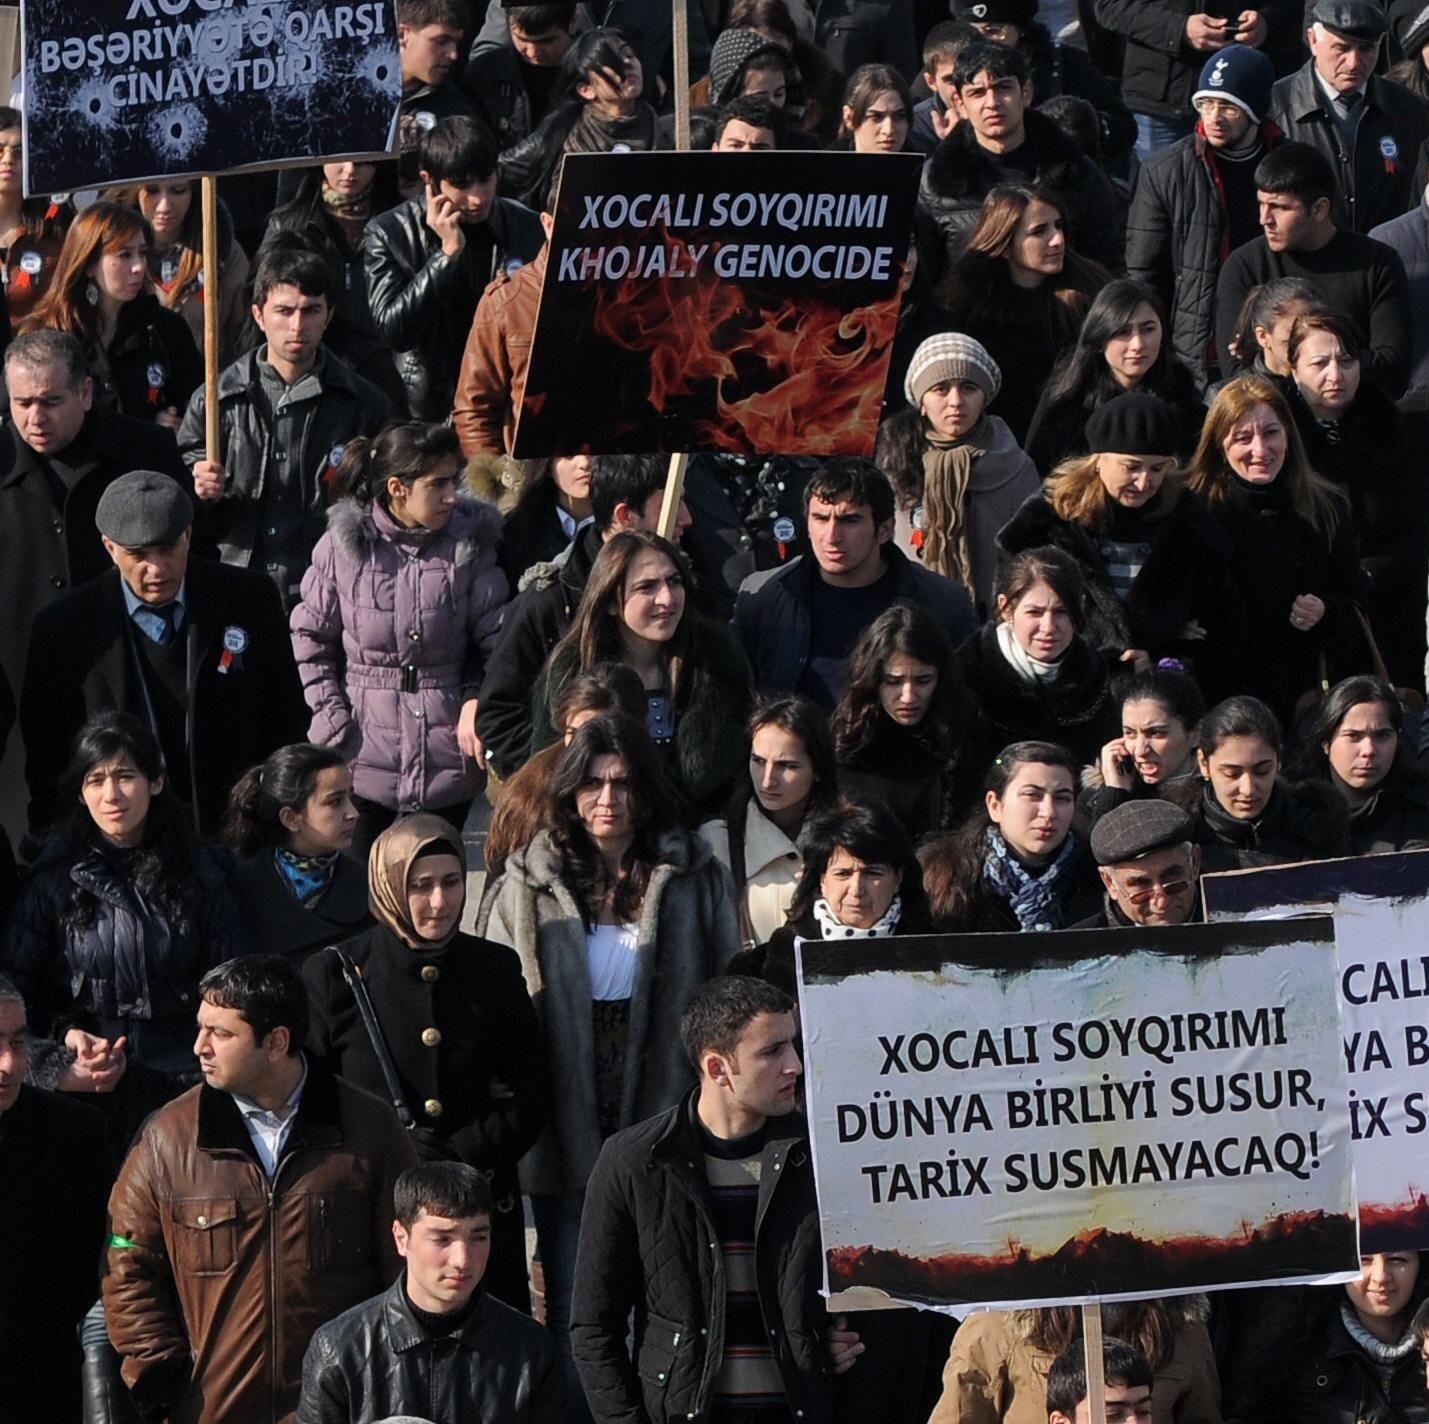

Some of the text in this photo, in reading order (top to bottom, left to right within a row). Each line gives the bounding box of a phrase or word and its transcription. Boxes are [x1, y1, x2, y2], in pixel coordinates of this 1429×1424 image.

[286, 2, 385, 46] QARŞI
[579, 193, 888, 231] XOCALI SOYQIRIMI
[558, 245, 893, 282] KHOJALY GENOCIDE
[878, 1025, 1040, 1076] XOCALI
[1053, 1006, 1288, 1064] SOYQIRIMI
[836, 1068, 1327, 1144] DÜNYA BİRLİYİ SUSUR,
[862, 1130, 1321, 1204] TARİX SUSMAYACAQ!
